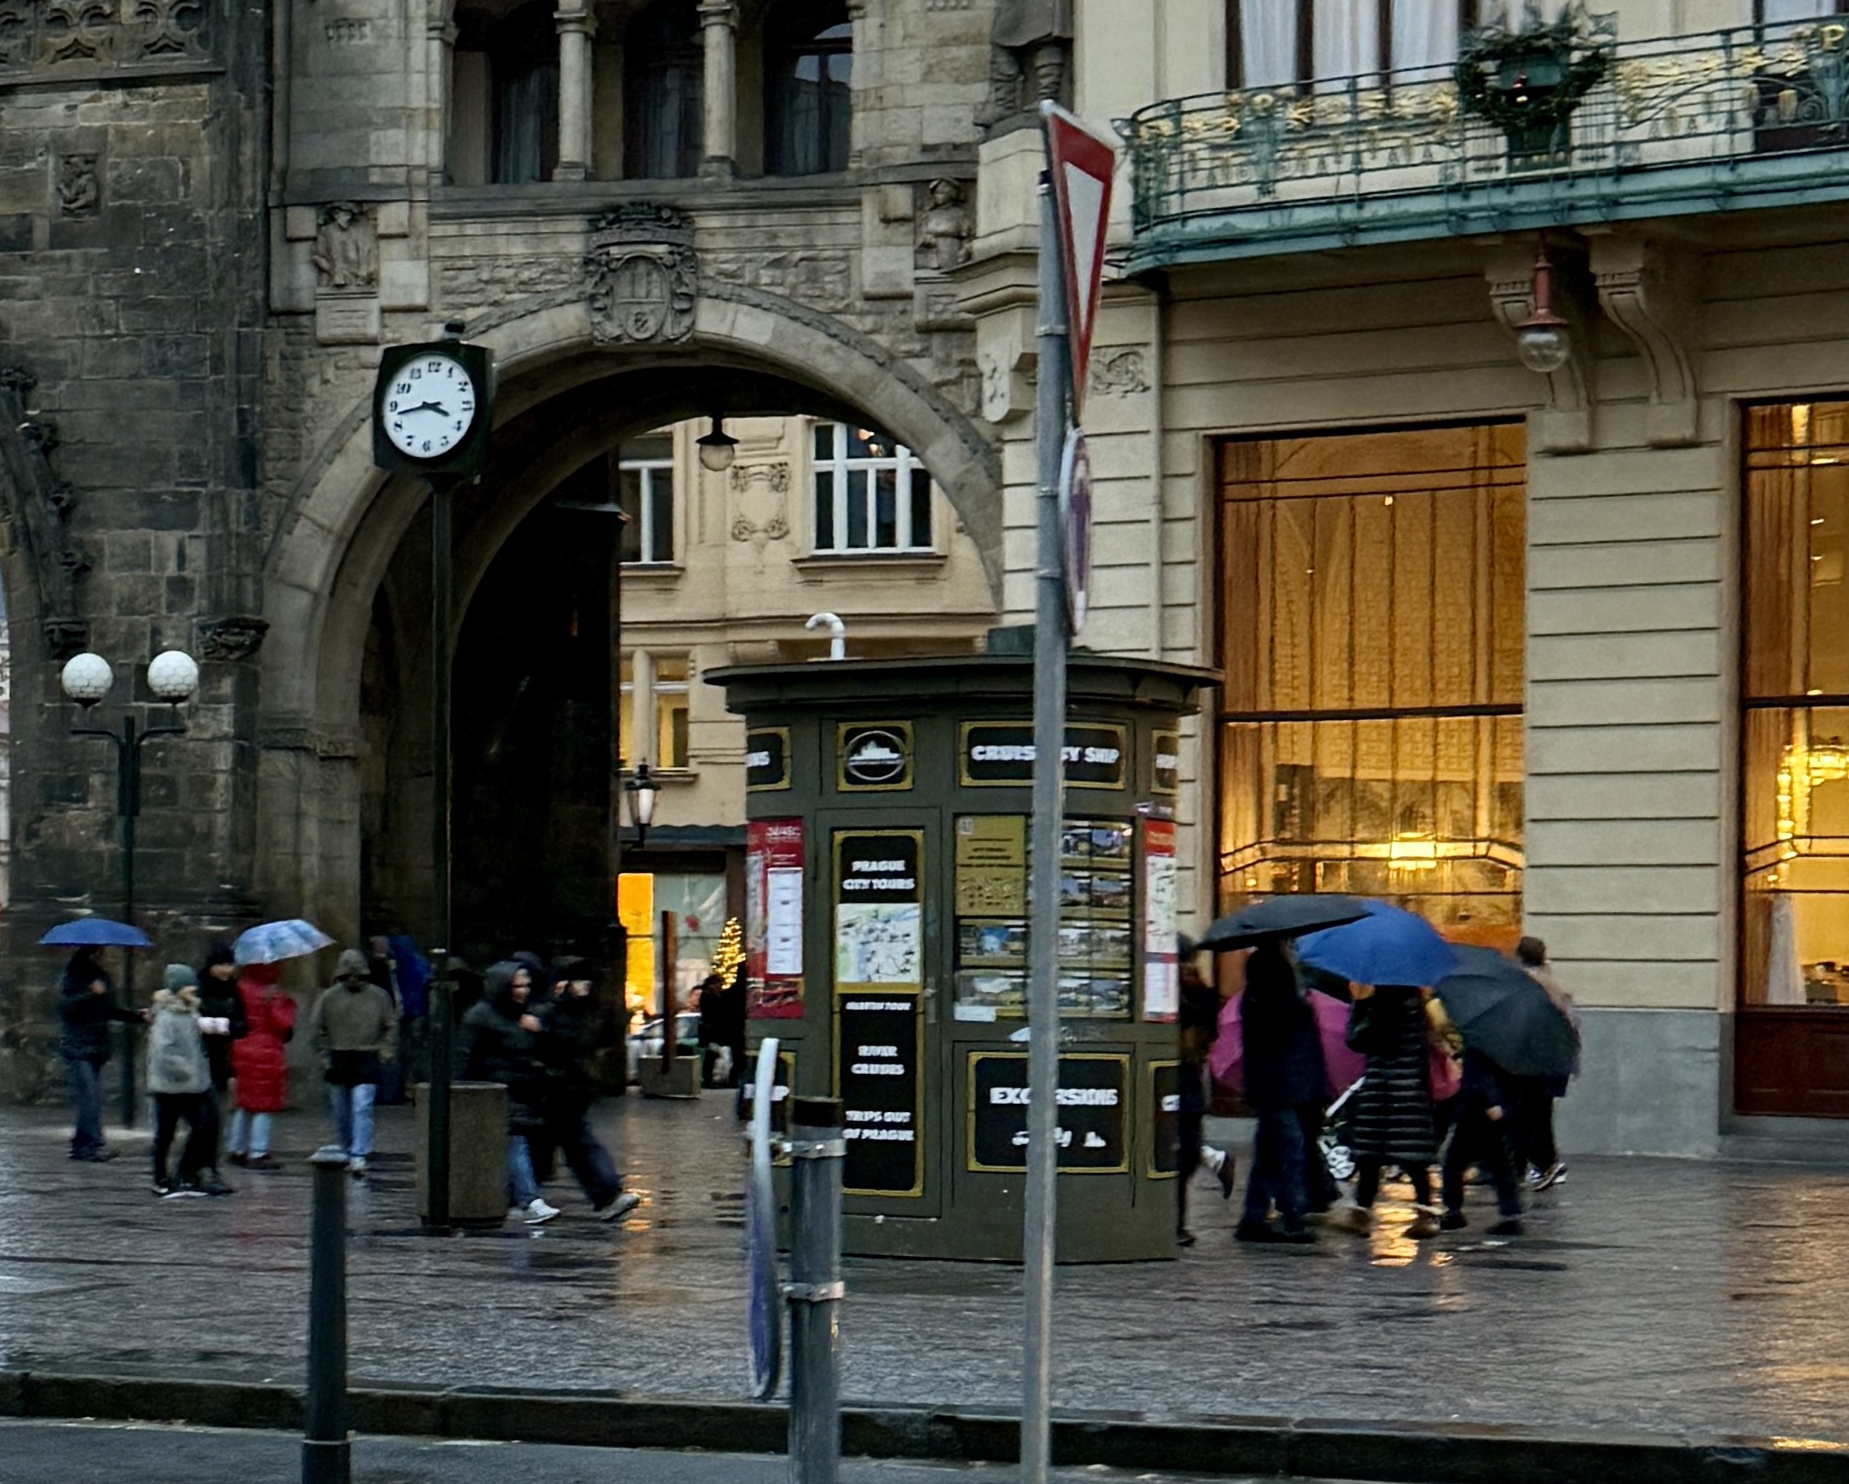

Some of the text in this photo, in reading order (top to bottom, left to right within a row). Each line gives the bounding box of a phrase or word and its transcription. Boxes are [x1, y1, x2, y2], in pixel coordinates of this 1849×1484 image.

[971, 745, 1037, 761] CRUIS
[1084, 747, 1120, 764] SHIP
[852, 860, 906, 872] PRAGUE
[872, 878, 916, 890] TOURS
[861, 1129, 915, 1141] PRAGUE
